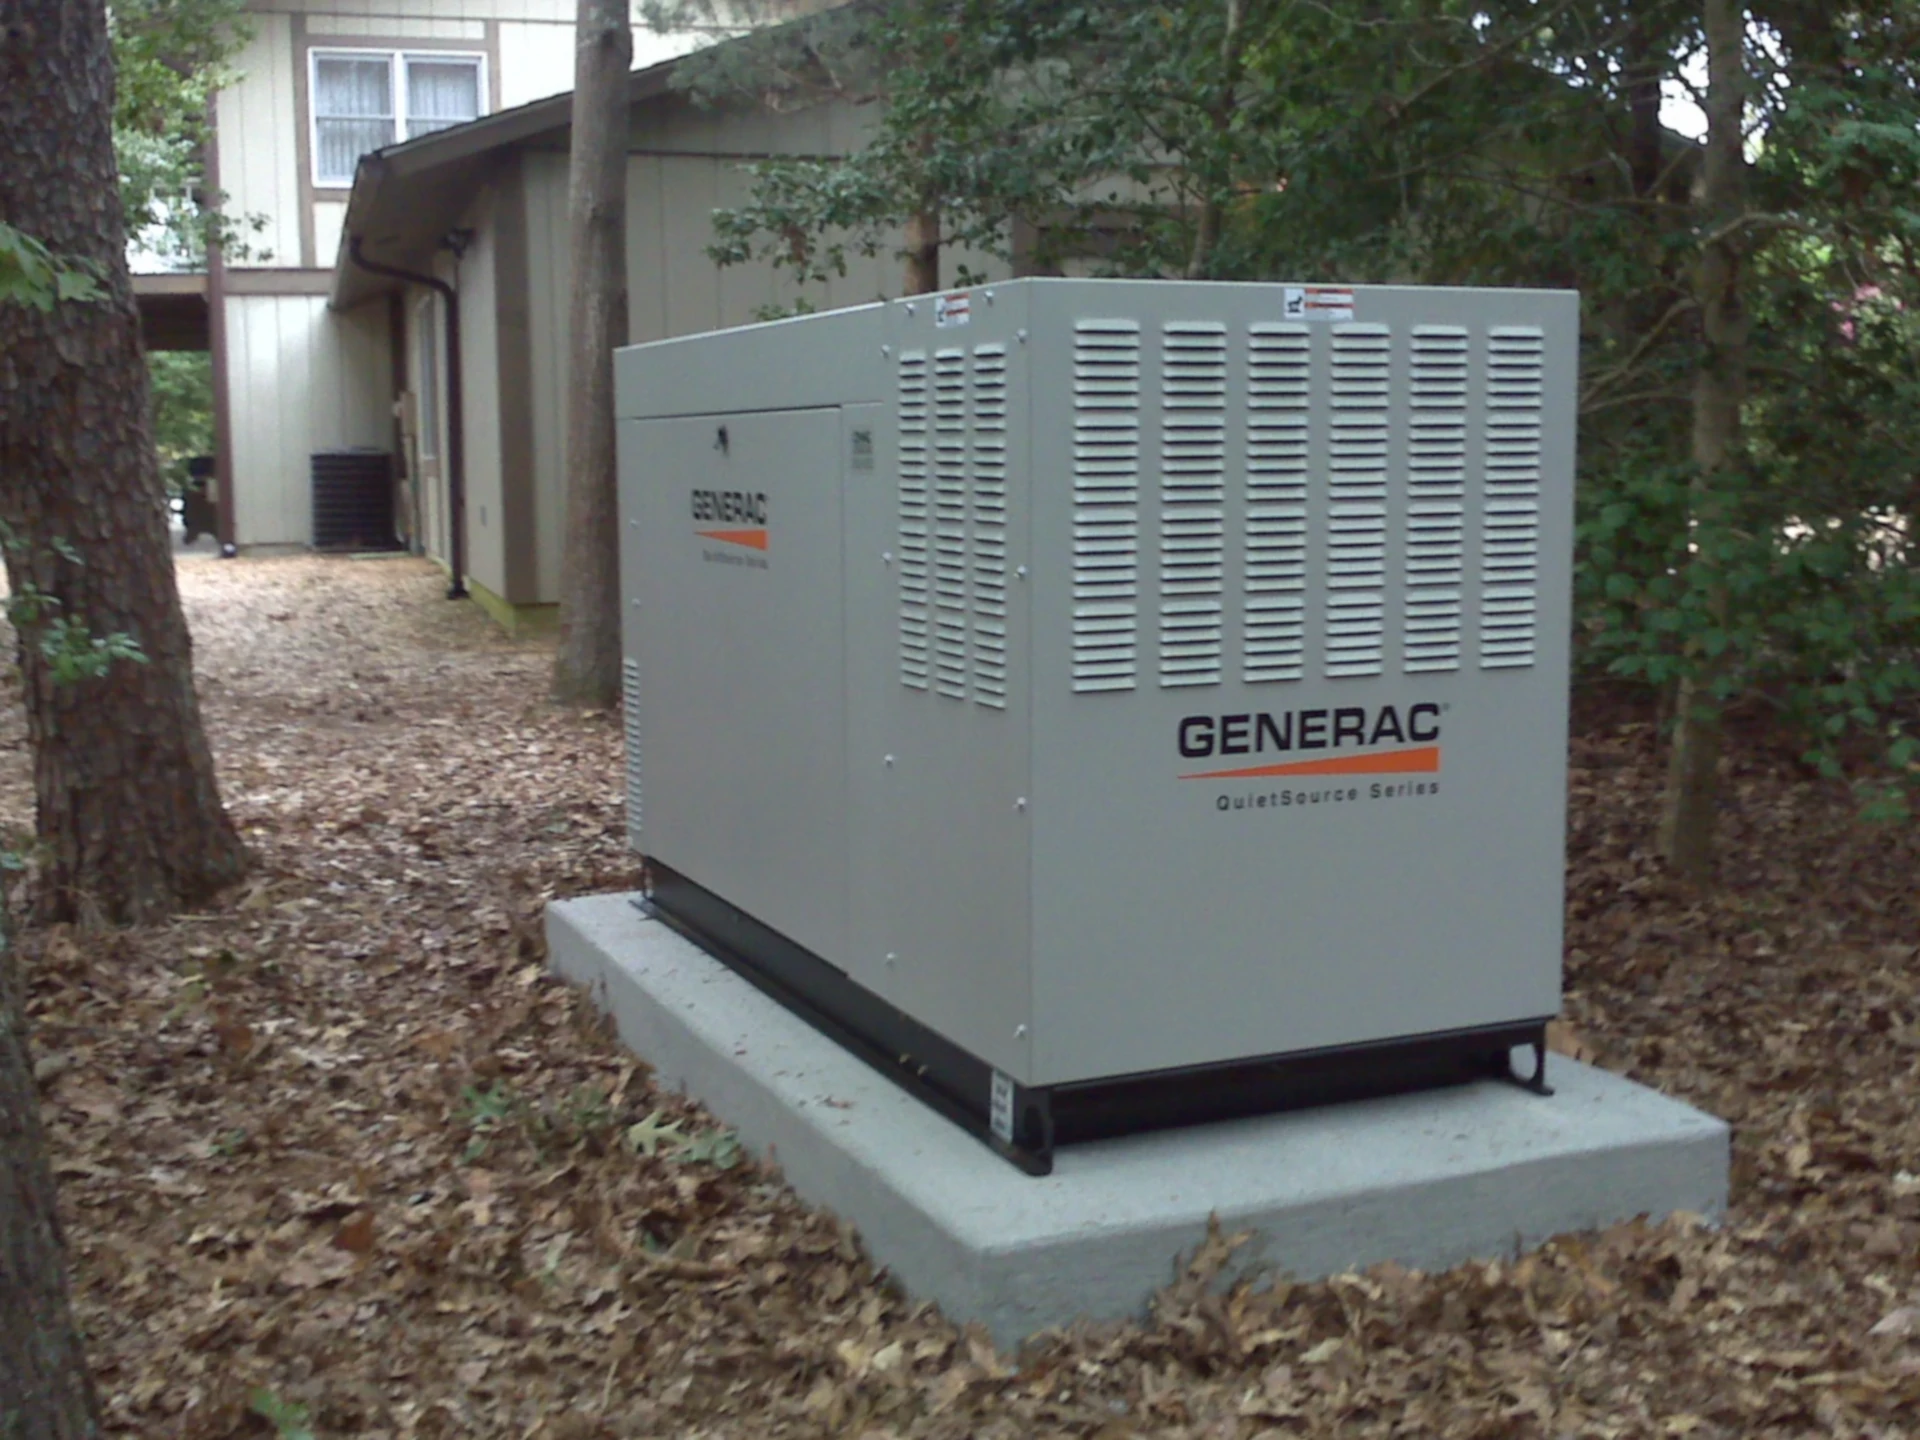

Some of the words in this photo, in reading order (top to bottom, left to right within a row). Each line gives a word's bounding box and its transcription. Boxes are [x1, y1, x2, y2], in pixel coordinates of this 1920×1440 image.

[691, 489, 767, 525] GENERAC
[1178, 702, 1440, 758] GENERAC
[1216, 786, 1358, 811] QuietSource
[1369, 781, 1440, 799] Series
